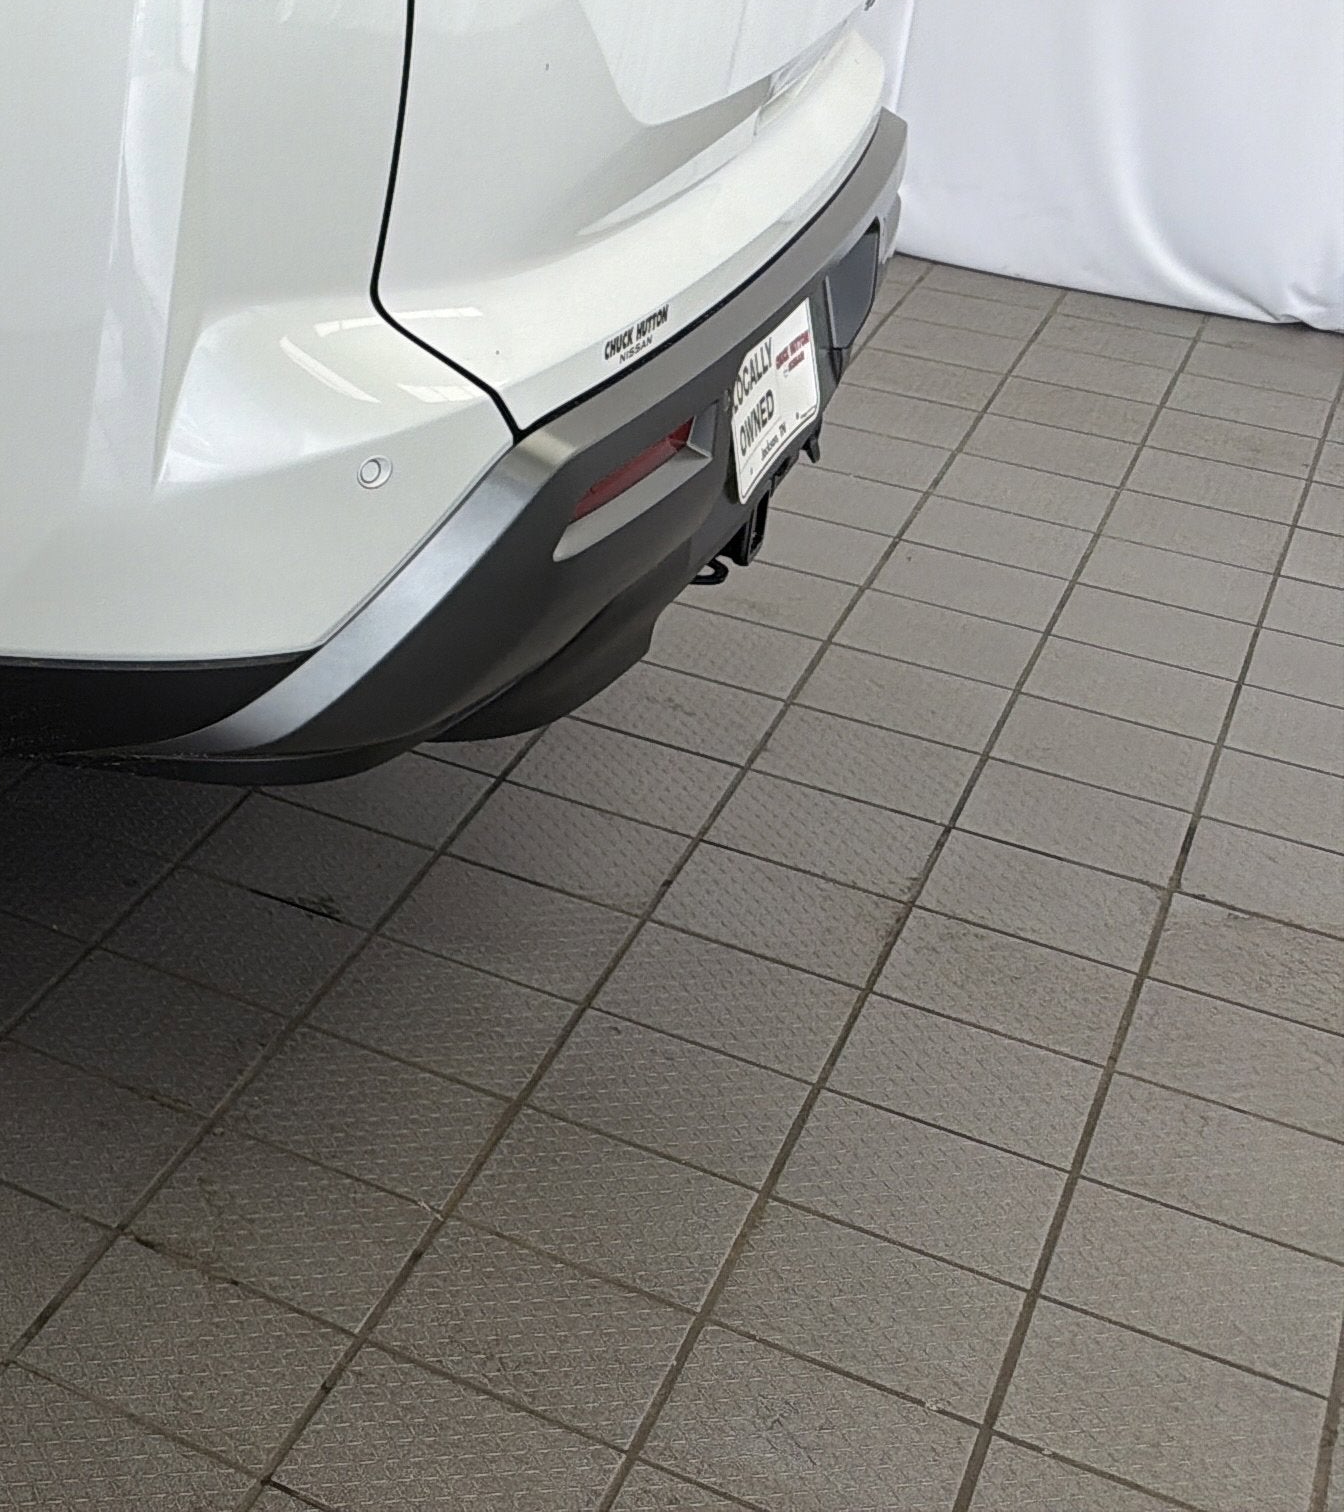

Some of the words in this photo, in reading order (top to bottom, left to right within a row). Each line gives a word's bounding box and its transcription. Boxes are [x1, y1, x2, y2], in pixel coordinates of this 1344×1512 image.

[604, 326, 634, 360] CHUCK
[635, 303, 670, 341] HUTTON
[619, 334, 653, 364] NISSAN
[732, 336, 773, 412] LOCALLY
[739, 388, 775, 457] OWNED
